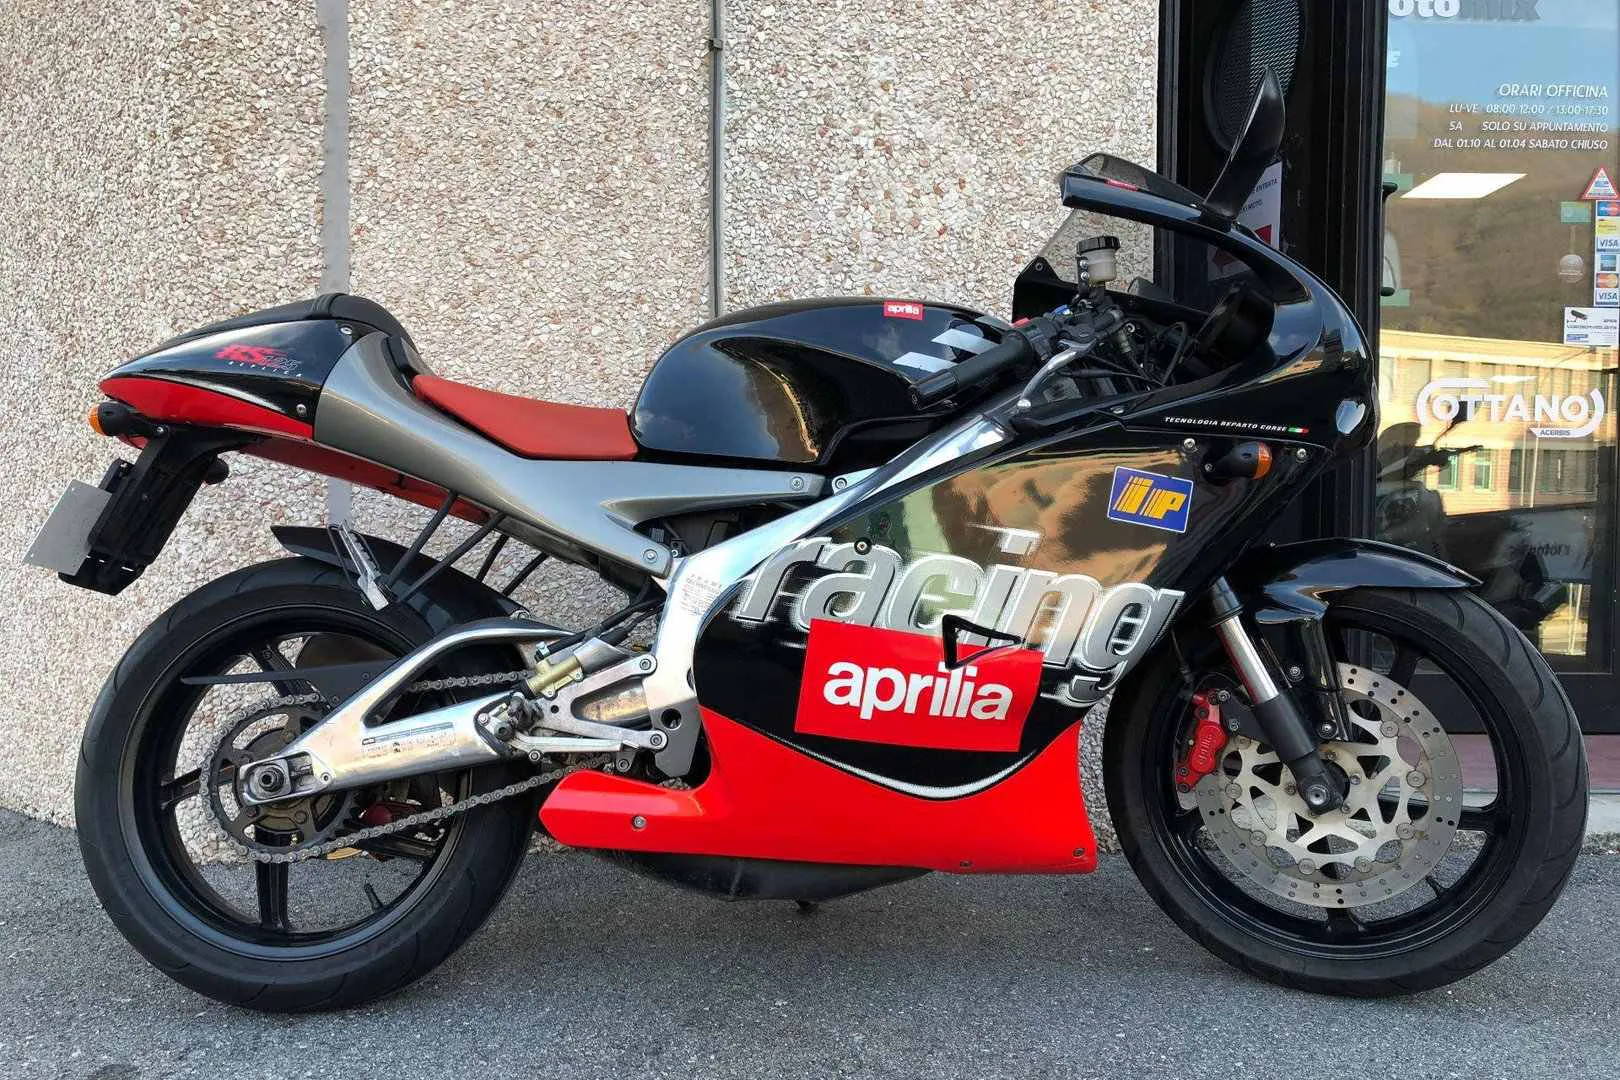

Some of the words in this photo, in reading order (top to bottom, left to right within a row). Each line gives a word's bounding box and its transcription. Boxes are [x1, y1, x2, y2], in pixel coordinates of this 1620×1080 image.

[1499, 83, 1542, 96] ORARI
[1546, 84, 1608, 98] OFFICINA
[1449, 121, 1463, 131] SA
[1482, 121, 1511, 131] SOLO
[1513, 121, 1527, 131] SU
[1529, 122, 1608, 132] APPUNTAMENTO
[1434, 138, 1454, 148] DAL
[1484, 138, 1497, 148] AL
[1529, 139, 1568, 149] SABATO
[1571, 140, 1608, 150] CHIUSO
[1600, 239, 1619, 247] VISA
[1599, 292, 1618, 300] VISA
[887, 304, 919, 315] aprilia
[1165, 416, 1218, 426] TECNOLOGIA
[1220, 420, 1258, 429] REPARTO
[1260, 424, 1287, 432] CORSE
[735, 527, 1186, 708] racing
[823, 661, 1014, 721] aprilia
